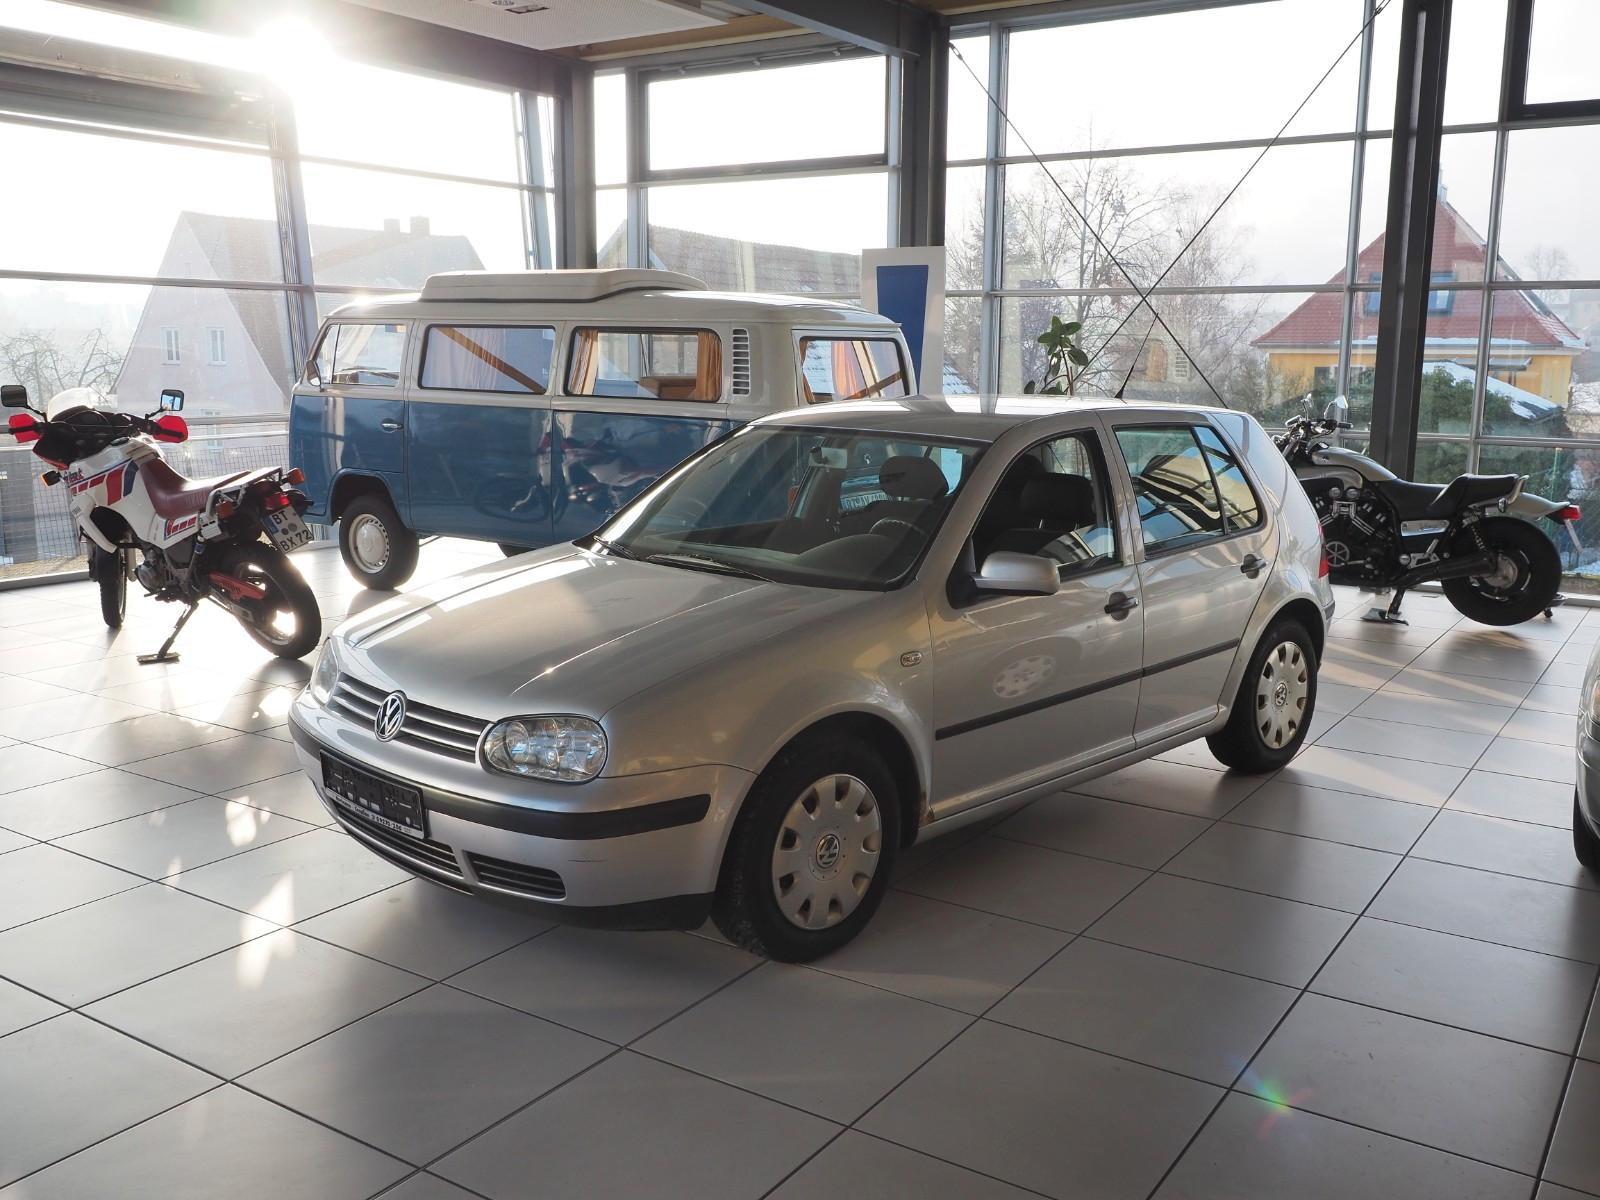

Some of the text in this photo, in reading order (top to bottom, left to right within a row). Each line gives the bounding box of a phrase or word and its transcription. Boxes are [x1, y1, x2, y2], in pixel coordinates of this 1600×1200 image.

[272, 510, 288, 525] BT
[280, 529, 312, 551] BX 72
